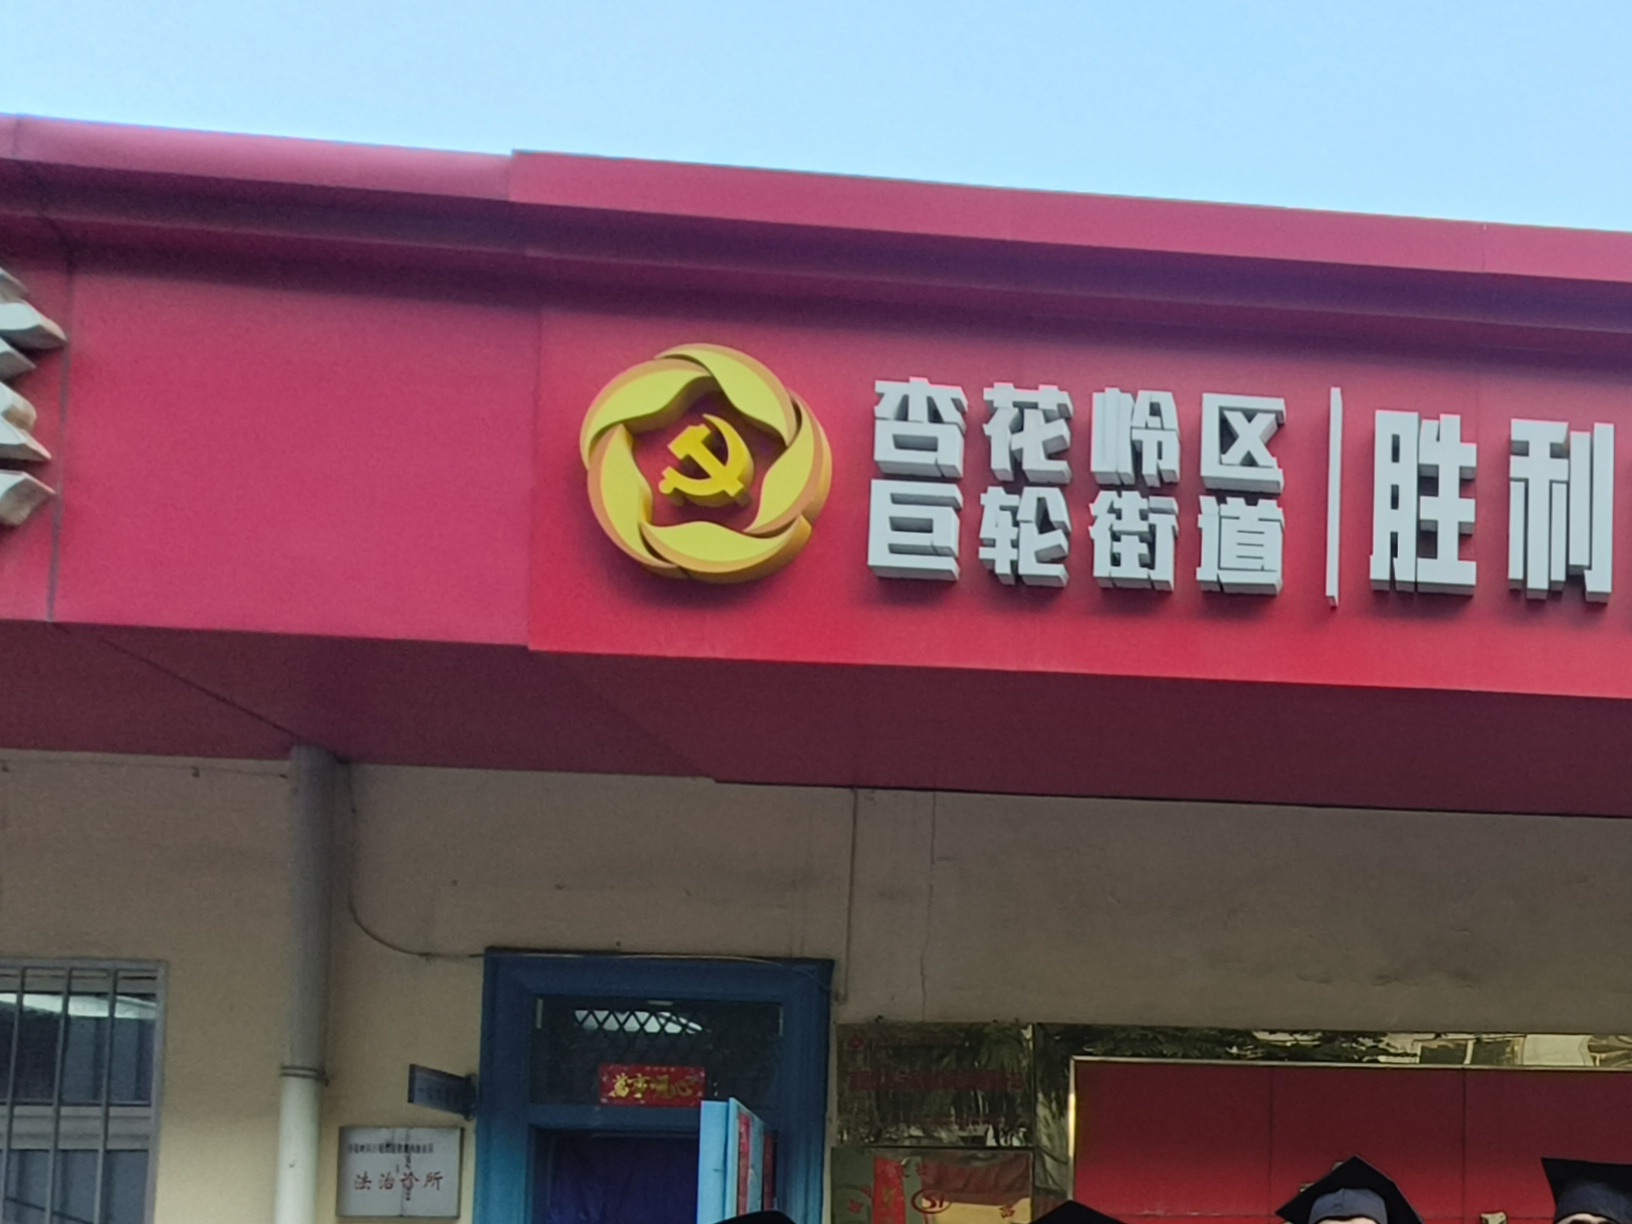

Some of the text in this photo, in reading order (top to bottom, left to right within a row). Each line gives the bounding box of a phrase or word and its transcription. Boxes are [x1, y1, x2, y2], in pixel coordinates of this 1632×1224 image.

[873, 376, 1286, 494] 杏花岭区
[867, 478, 1284, 596] 巨轮街道
